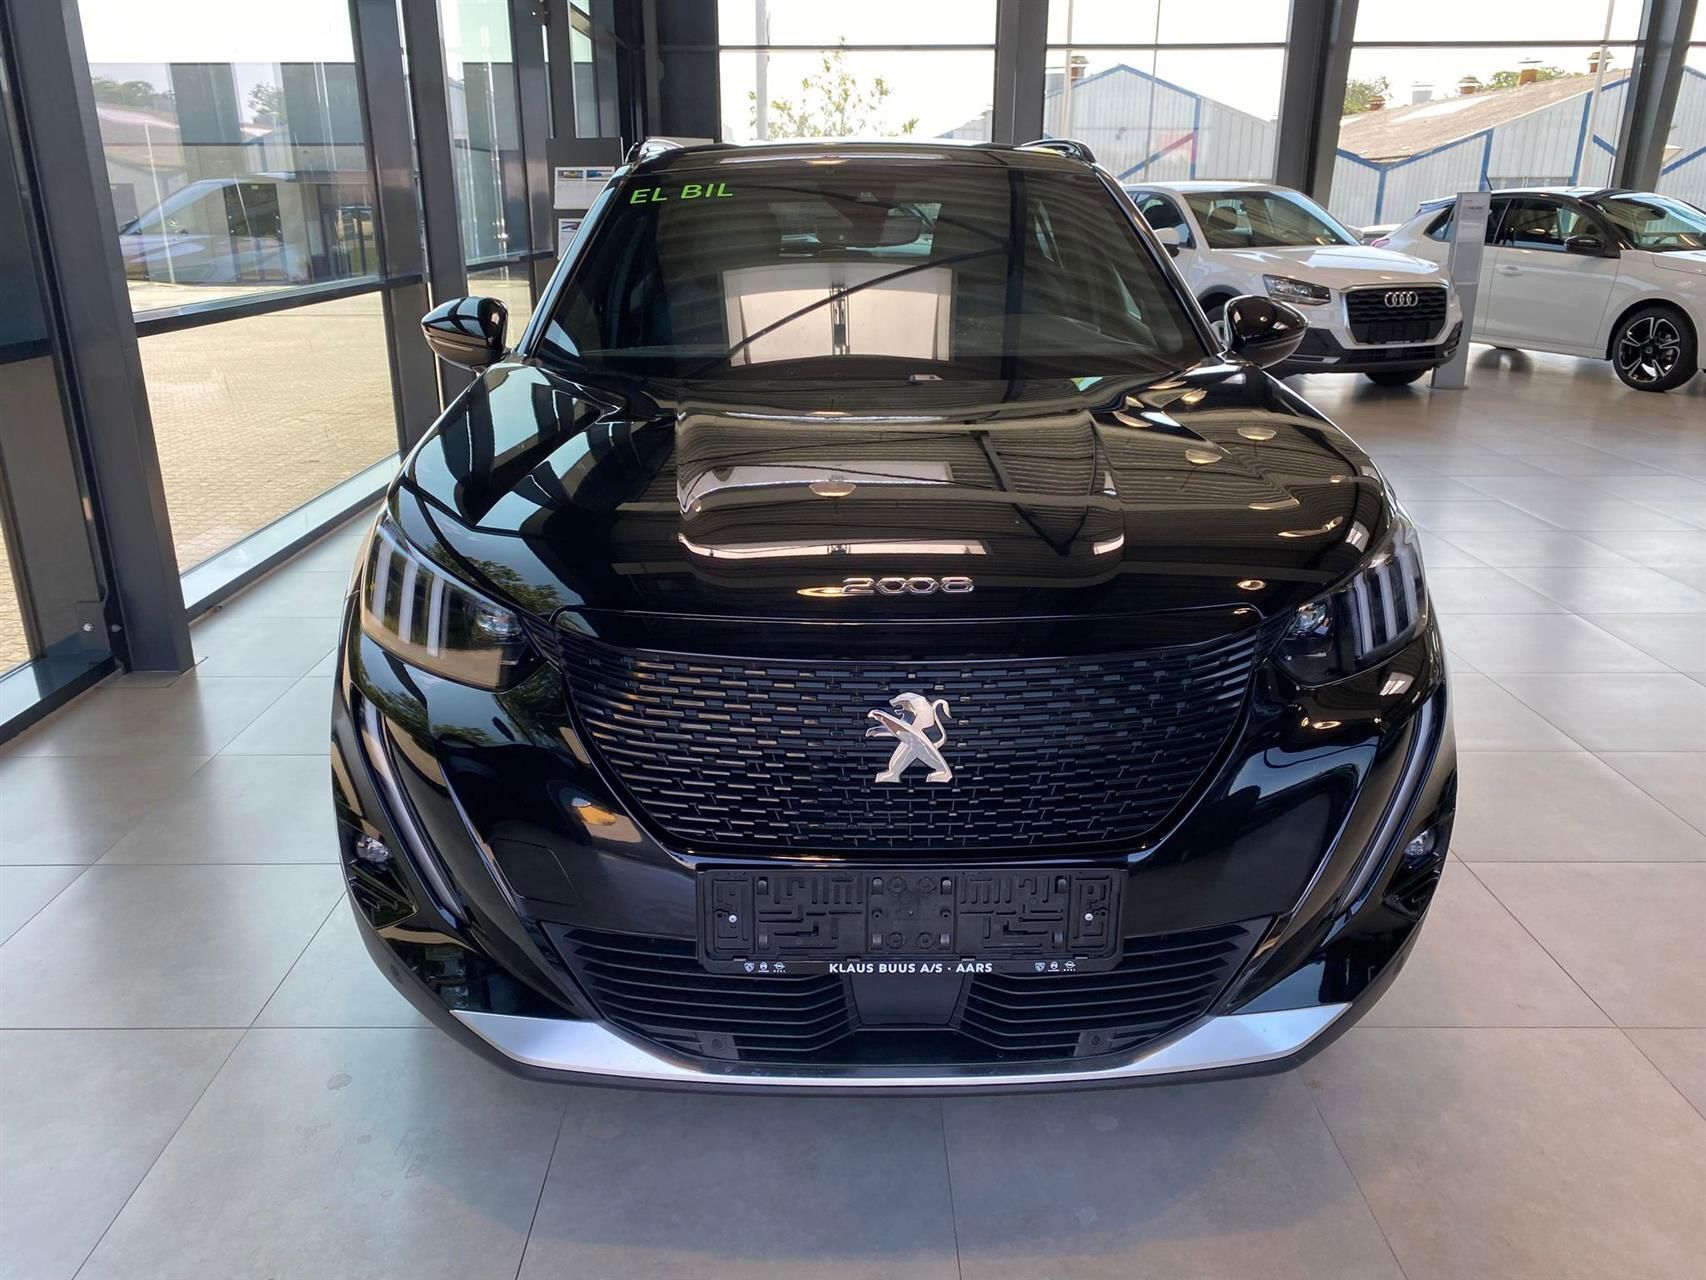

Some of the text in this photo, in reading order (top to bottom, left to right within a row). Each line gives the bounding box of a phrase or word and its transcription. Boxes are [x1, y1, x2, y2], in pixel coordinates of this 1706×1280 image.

[630, 183, 733, 204] EL BIL
[841, 576, 975, 595] 2008
[829, 963, 874, 973] KLAUS
[878, 963, 916, 973] BUUS
[920, 963, 943, 973] A/S
[955, 963, 993, 973] AARS
